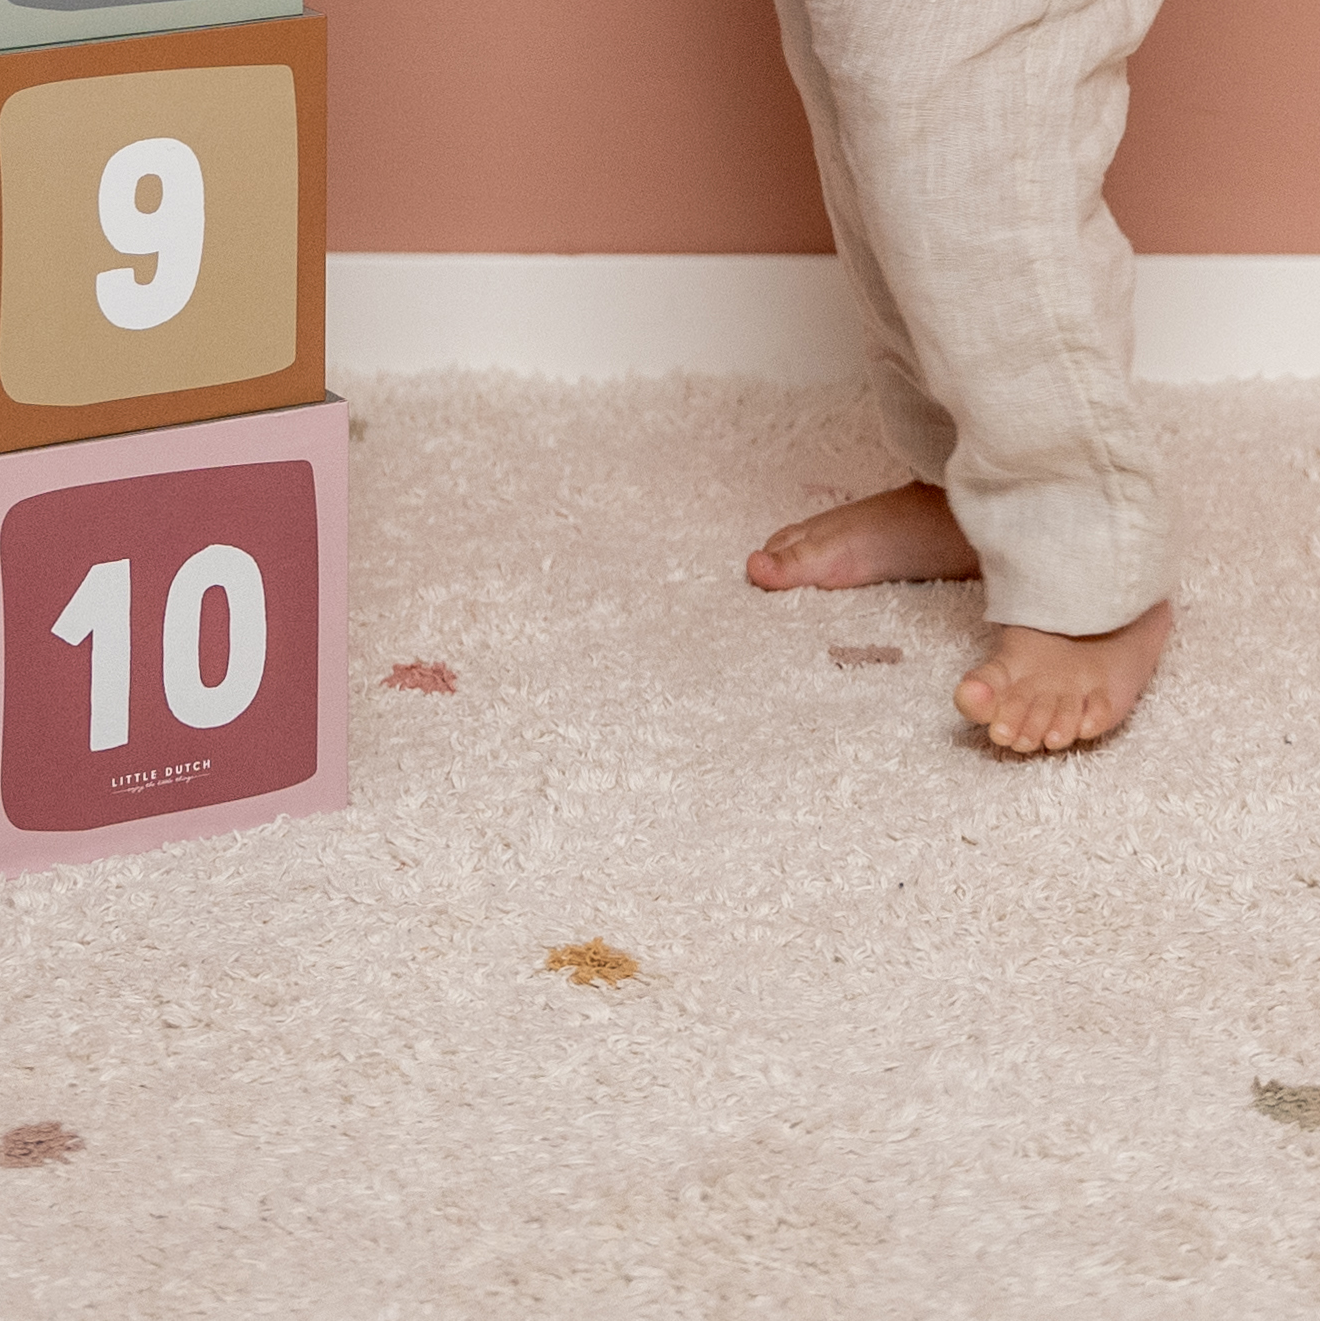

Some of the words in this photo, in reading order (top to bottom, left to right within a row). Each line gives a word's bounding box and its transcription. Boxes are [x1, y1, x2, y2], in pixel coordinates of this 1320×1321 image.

[96, 138, 204, 330] 9
[52, 545, 266, 750] 10
[111, 769, 157, 787] LITTLE
[165, 759, 211, 777] DUTCH
